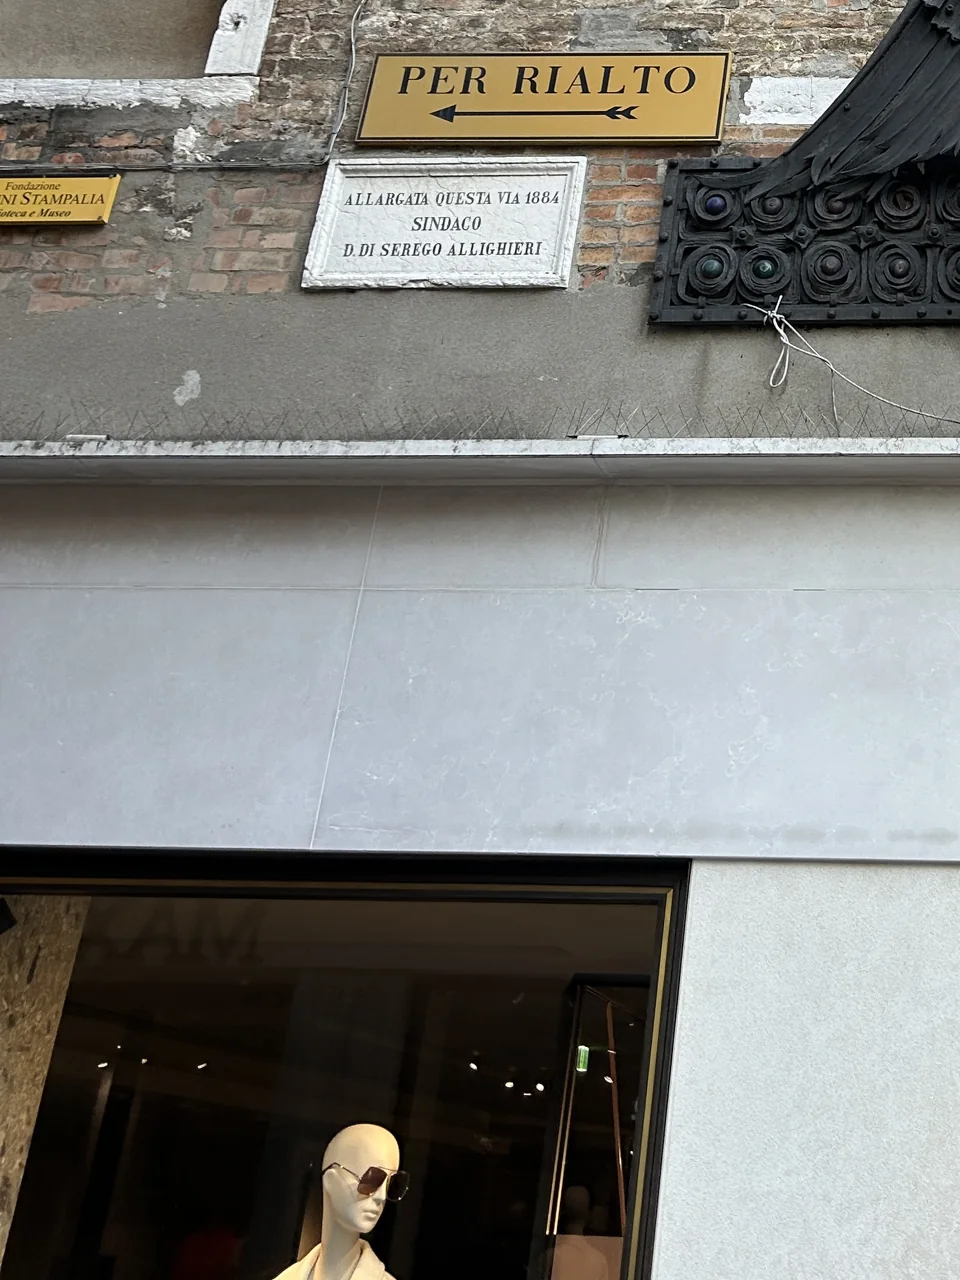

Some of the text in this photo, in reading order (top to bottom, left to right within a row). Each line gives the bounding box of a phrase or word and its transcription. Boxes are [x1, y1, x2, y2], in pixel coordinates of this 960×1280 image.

[397, 65, 697, 95] PER RIALTO
[5, 181, 61, 191] Fondazione
[0, 191, 105, 206] NI STAMPALIA
[344, 191, 560, 207] ALLARGATA QUESTA VIA 1884
[28, 210, 36, 218] e
[38, 208, 72, 218] Museo
[411, 216, 482, 231] SINDACO
[379, 242, 442, 257] SEREGO
[447, 241, 543, 256] ALLIGHIERI
